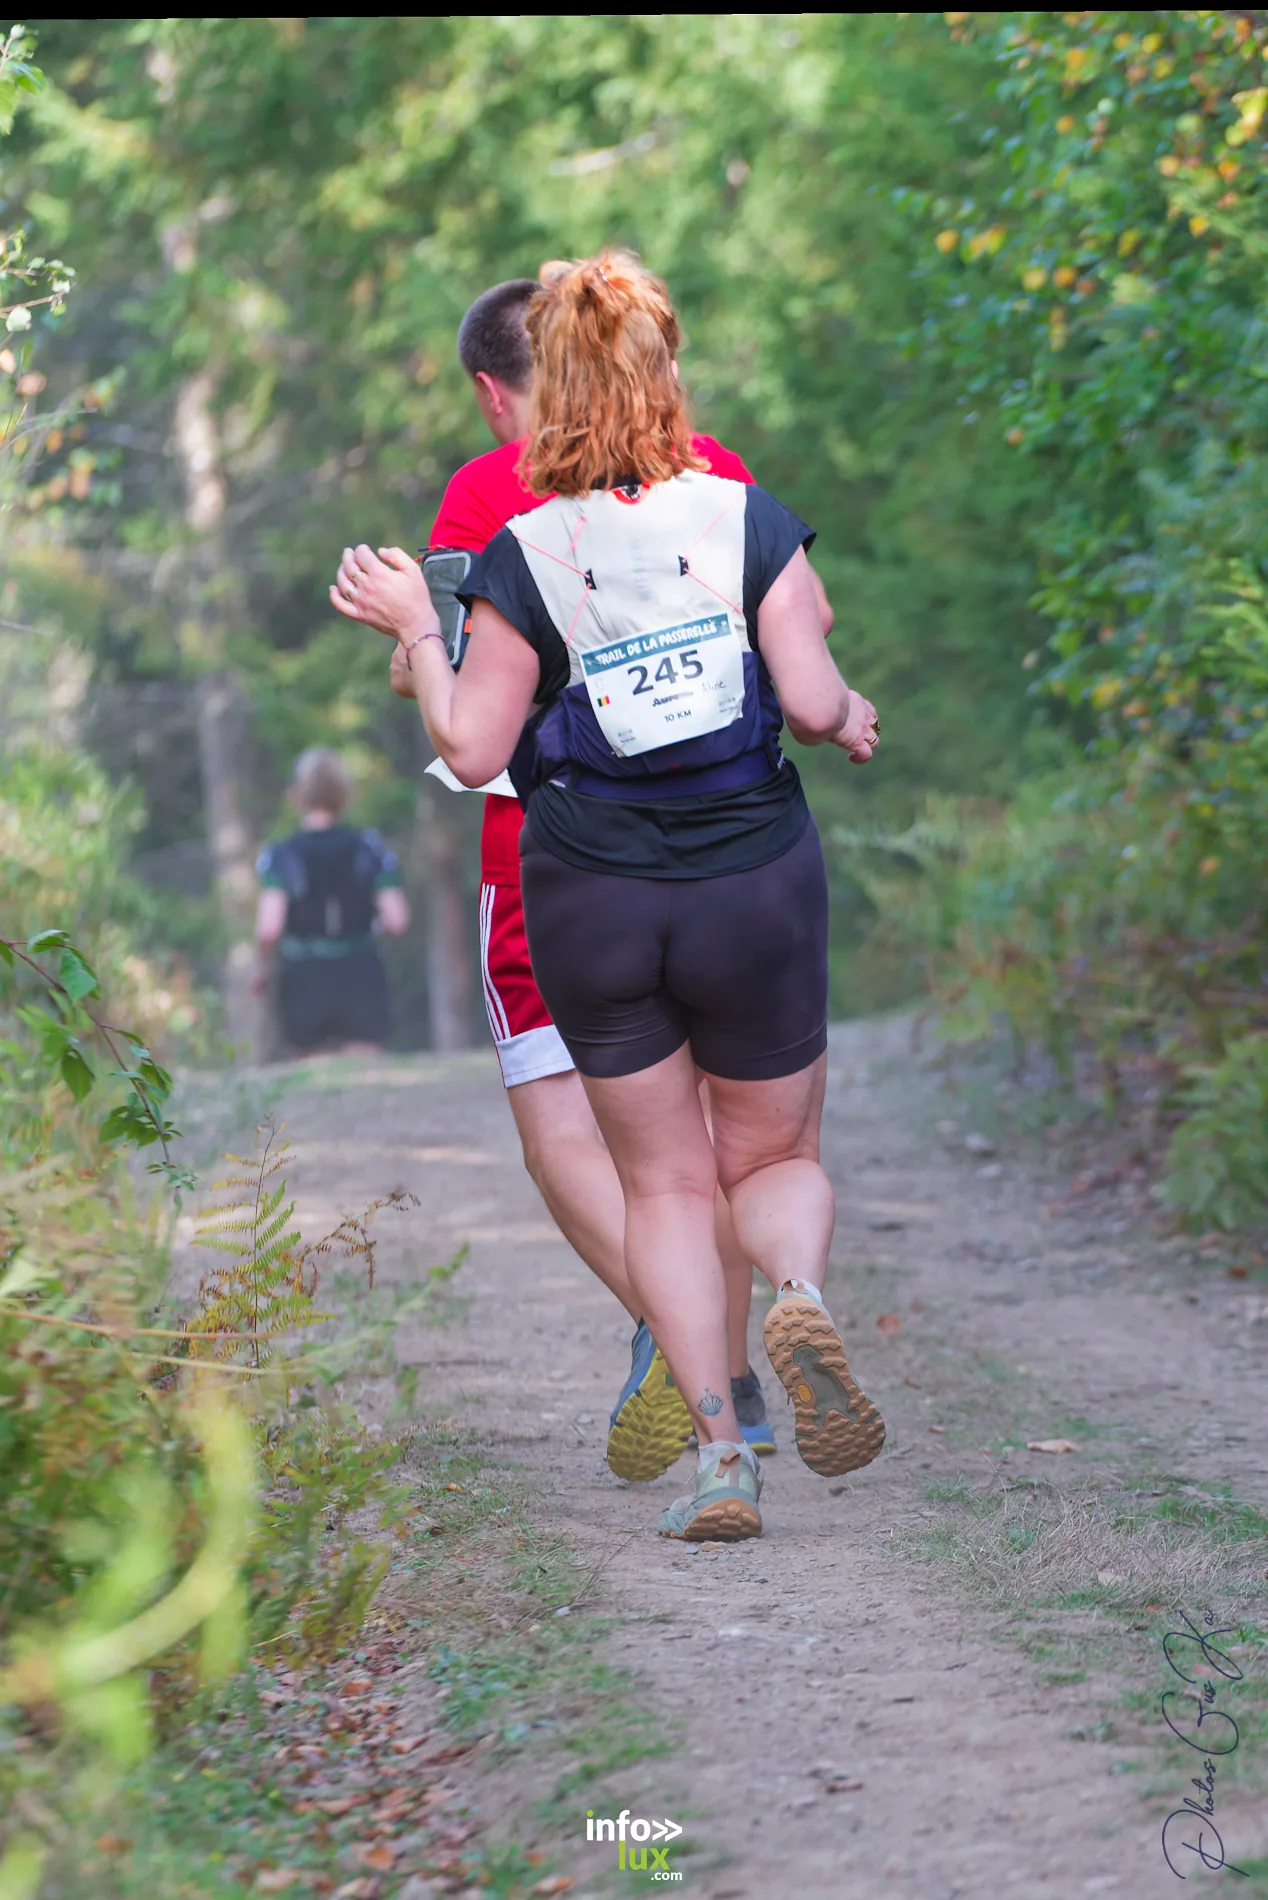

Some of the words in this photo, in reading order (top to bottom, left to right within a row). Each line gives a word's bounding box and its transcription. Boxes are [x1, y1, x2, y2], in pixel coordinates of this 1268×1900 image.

[595, 648, 625, 666] TRAIL
[627, 642, 642, 656] DE
[642, 637, 658, 651] LA
[627, 649, 703, 695] 245
[664, 714, 675, 722] 10
[677, 709, 692, 719] KM
